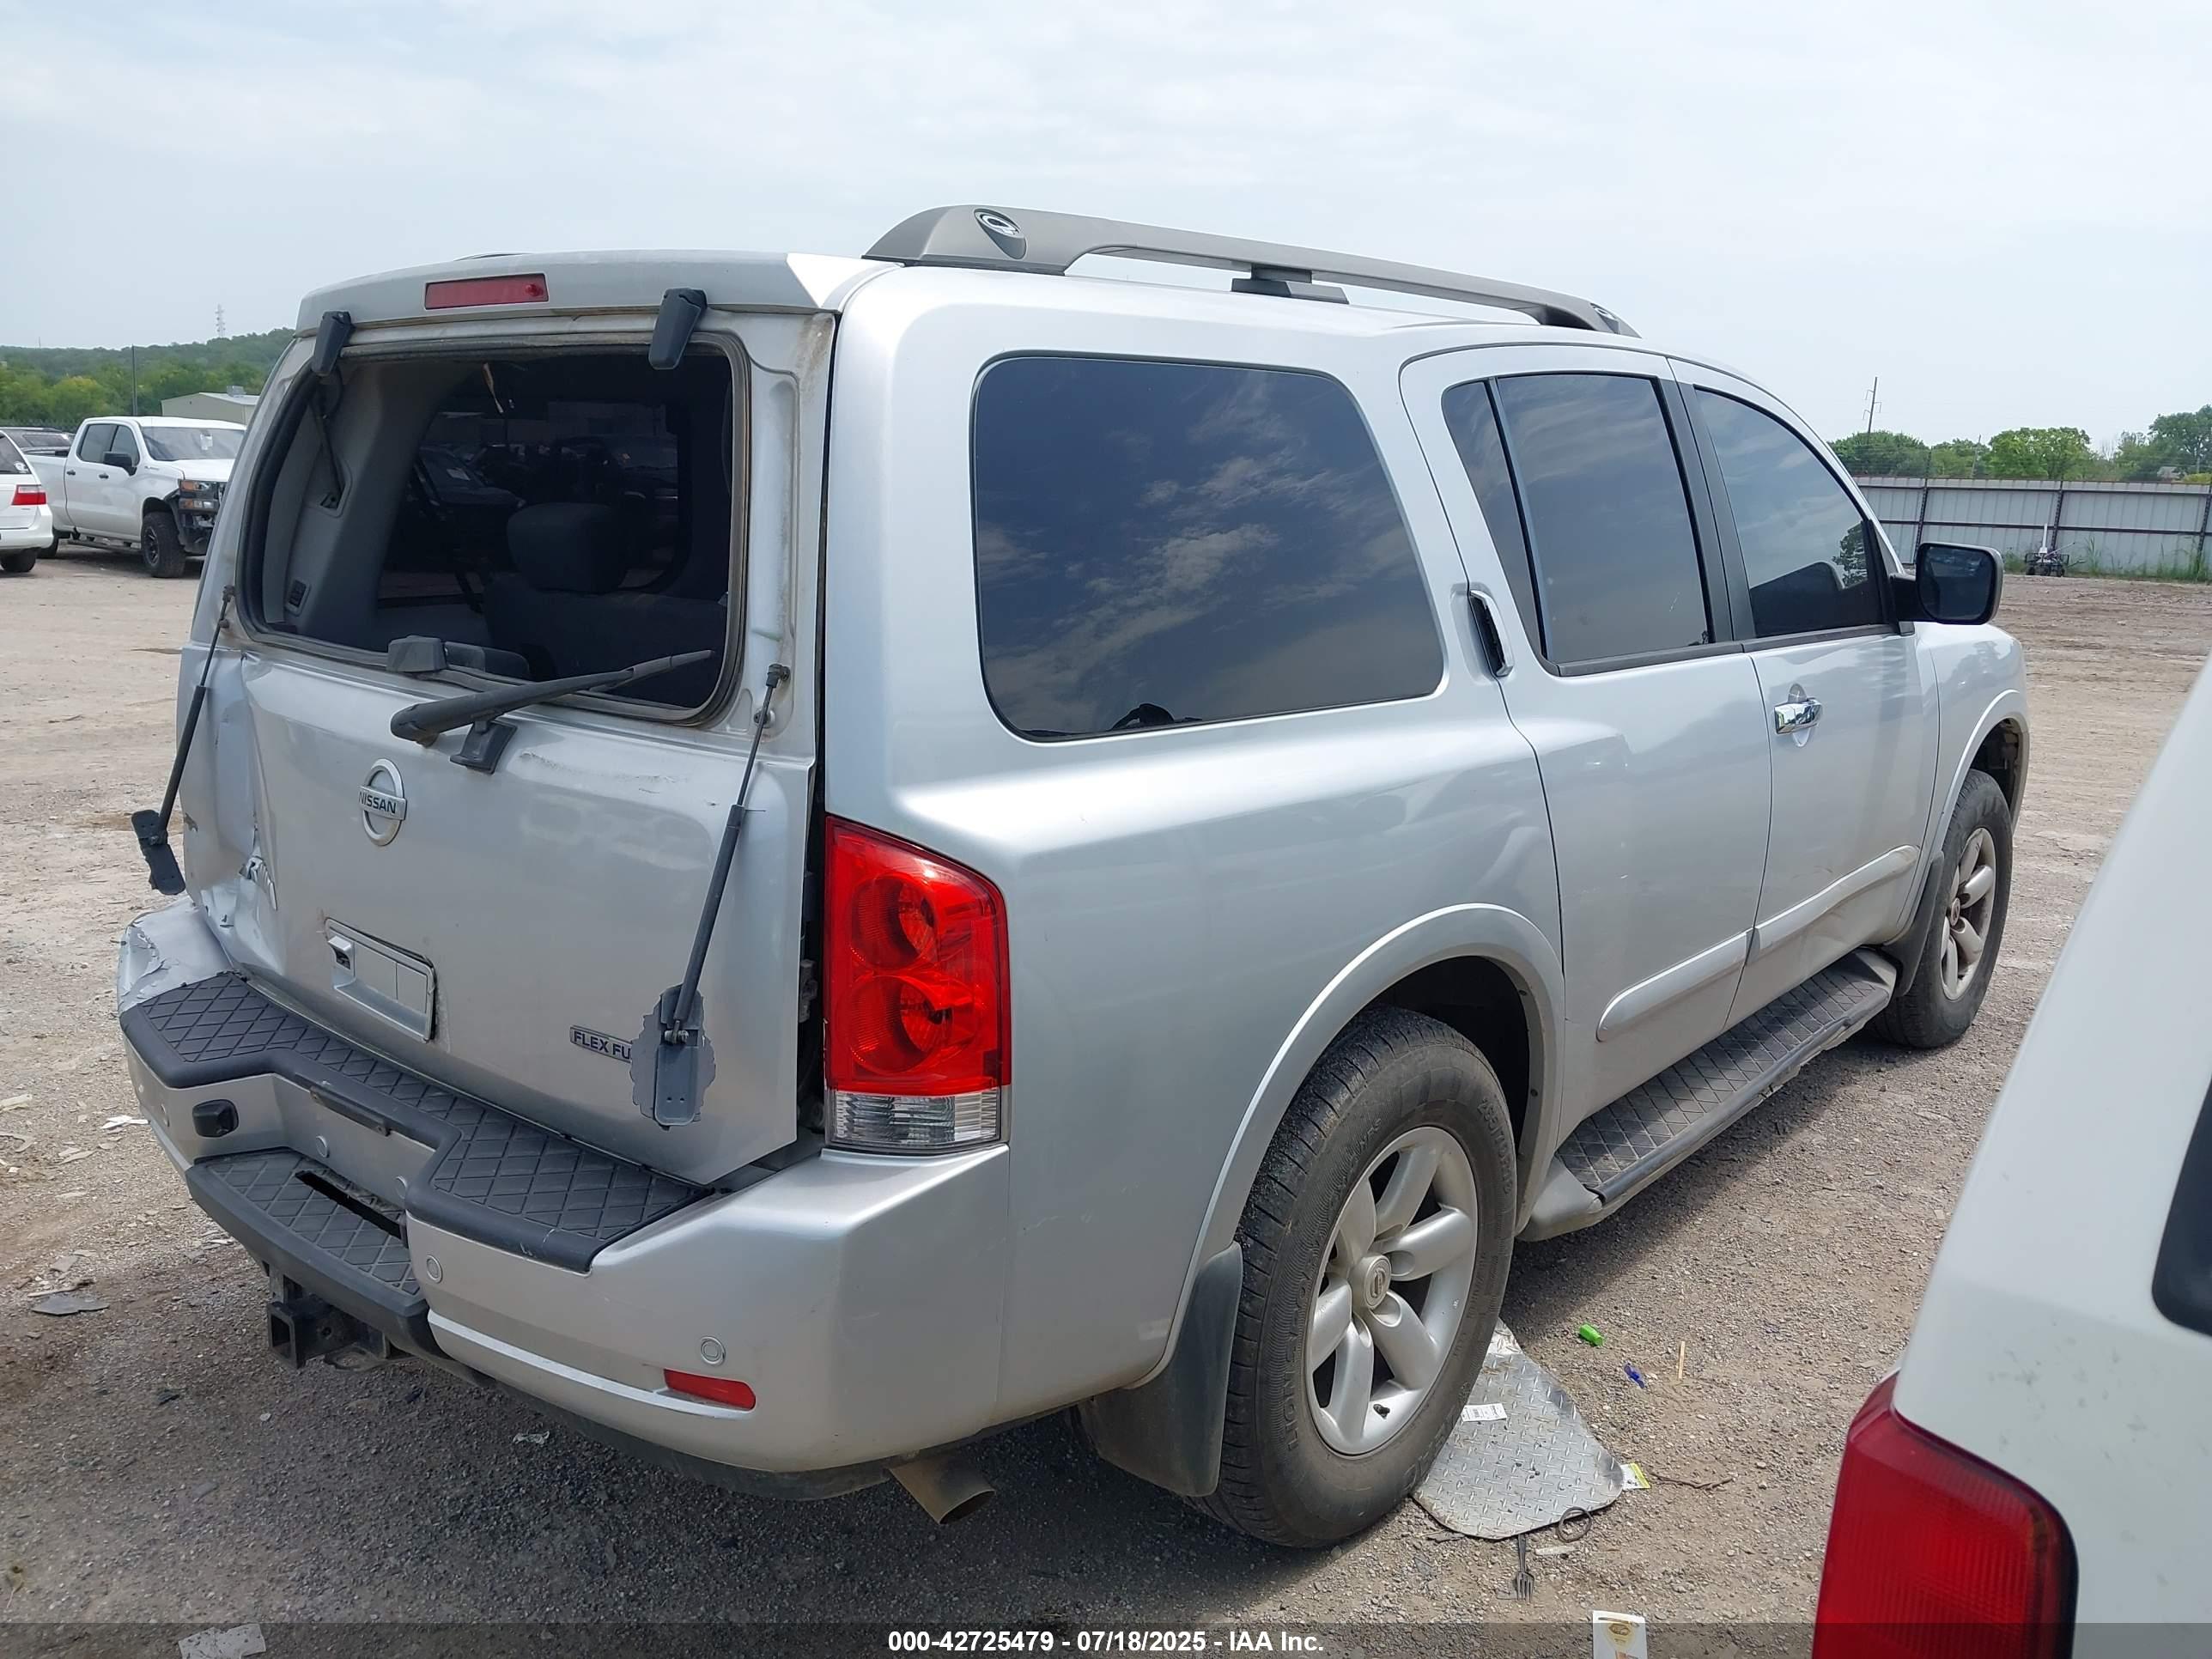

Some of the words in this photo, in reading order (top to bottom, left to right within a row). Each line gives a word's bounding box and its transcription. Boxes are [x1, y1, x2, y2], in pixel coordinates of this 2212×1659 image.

[358, 791, 397, 814] NISSAN
[574, 1030, 609, 1053] FLEX
[612, 1042, 631, 1060] FU
